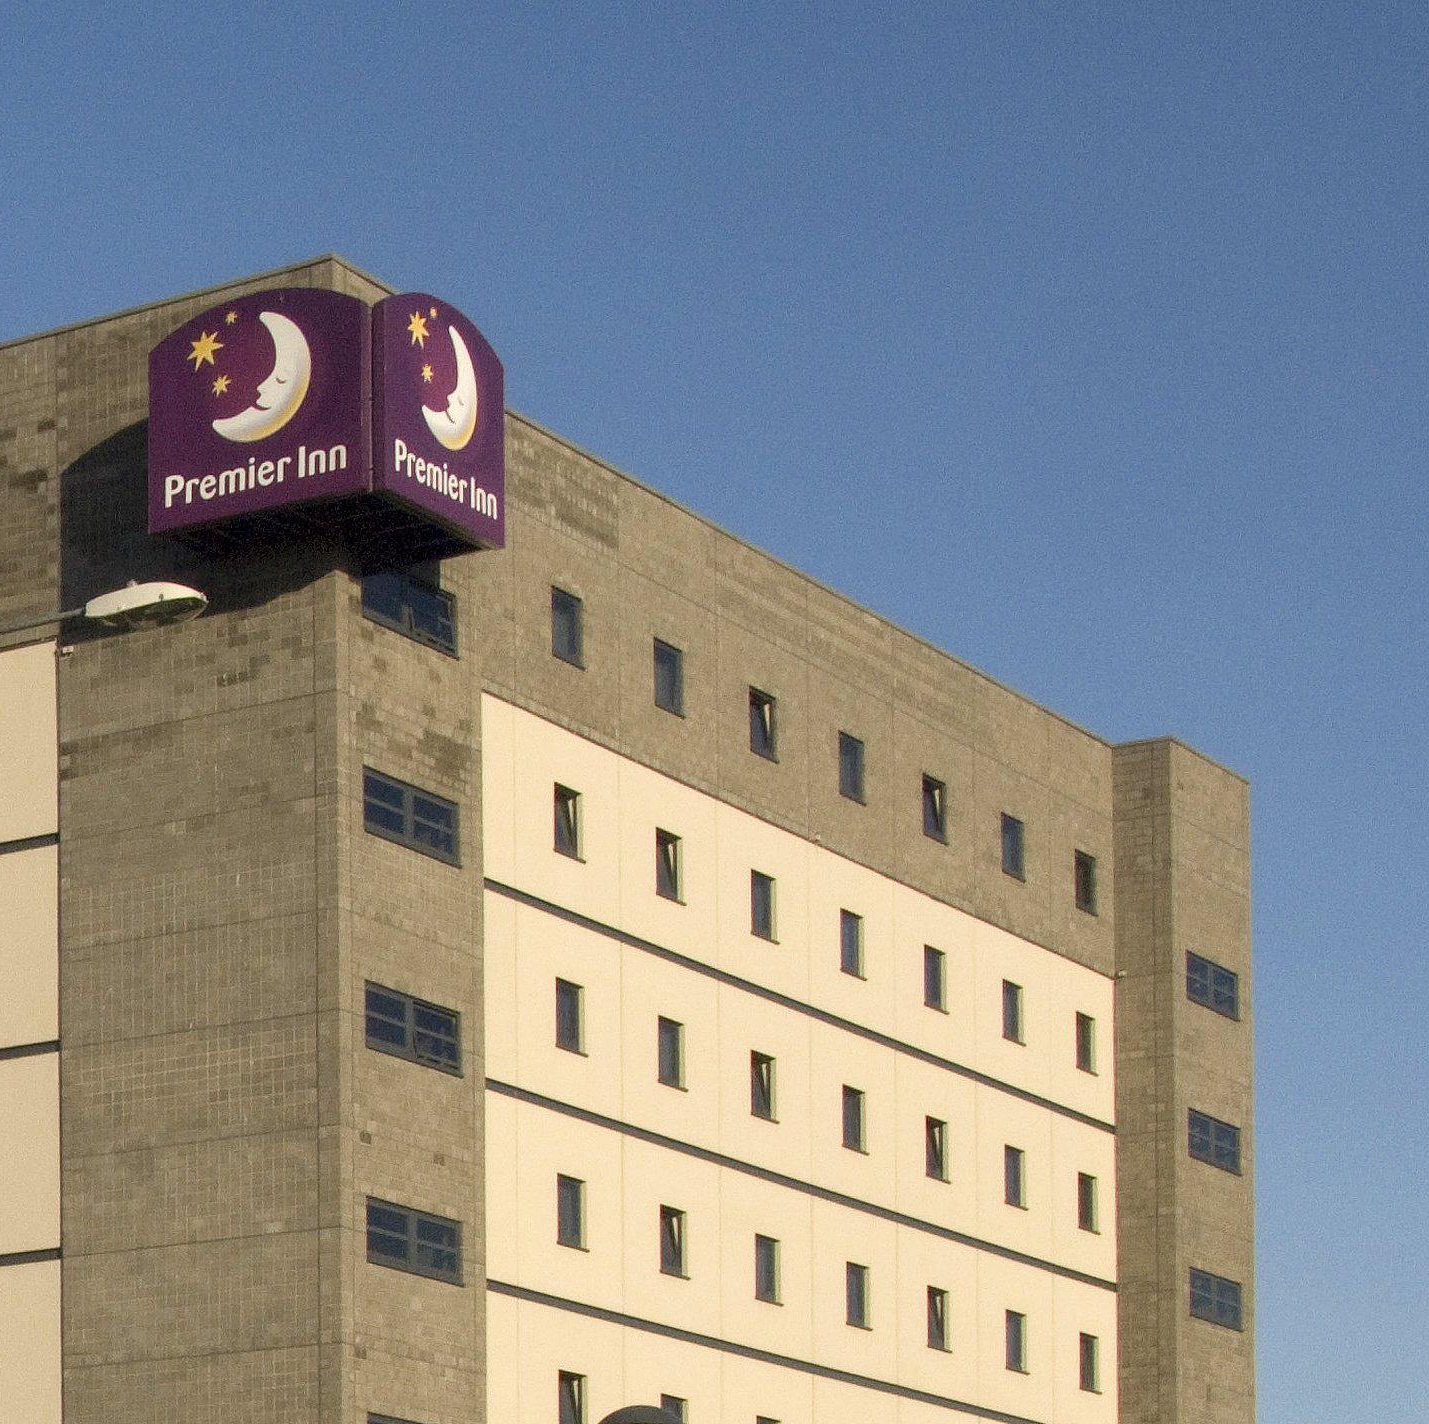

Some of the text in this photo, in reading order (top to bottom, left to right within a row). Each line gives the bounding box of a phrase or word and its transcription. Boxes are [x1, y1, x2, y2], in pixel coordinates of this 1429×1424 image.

[164, 444, 347, 508] Premier Inn
[394, 439, 498, 520] Premier Inn
